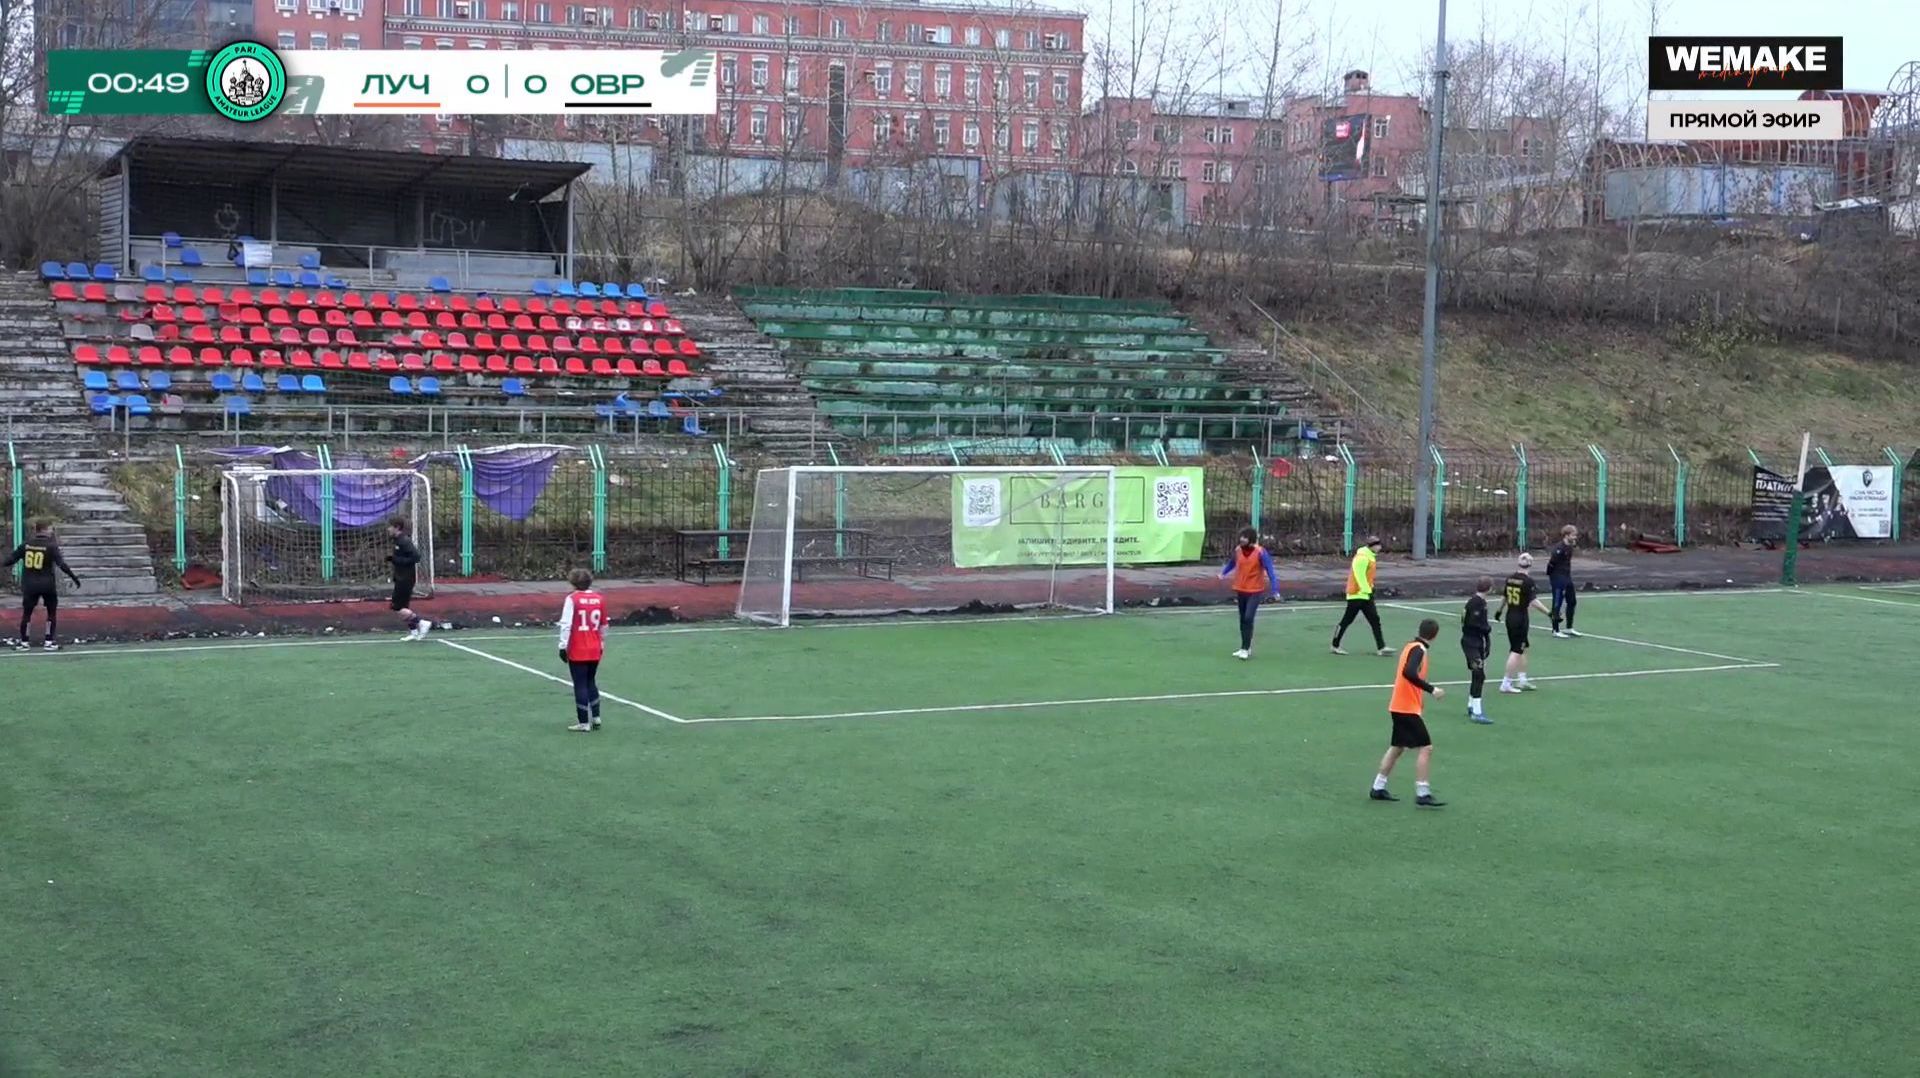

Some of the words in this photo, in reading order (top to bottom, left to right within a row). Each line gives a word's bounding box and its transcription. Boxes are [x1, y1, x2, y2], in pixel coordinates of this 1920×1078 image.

[1040, 492, 1104, 509] BARG
[25, 550, 44, 569] 60
[1507, 586, 1521, 605] 55
[578, 609, 601, 631] 19
